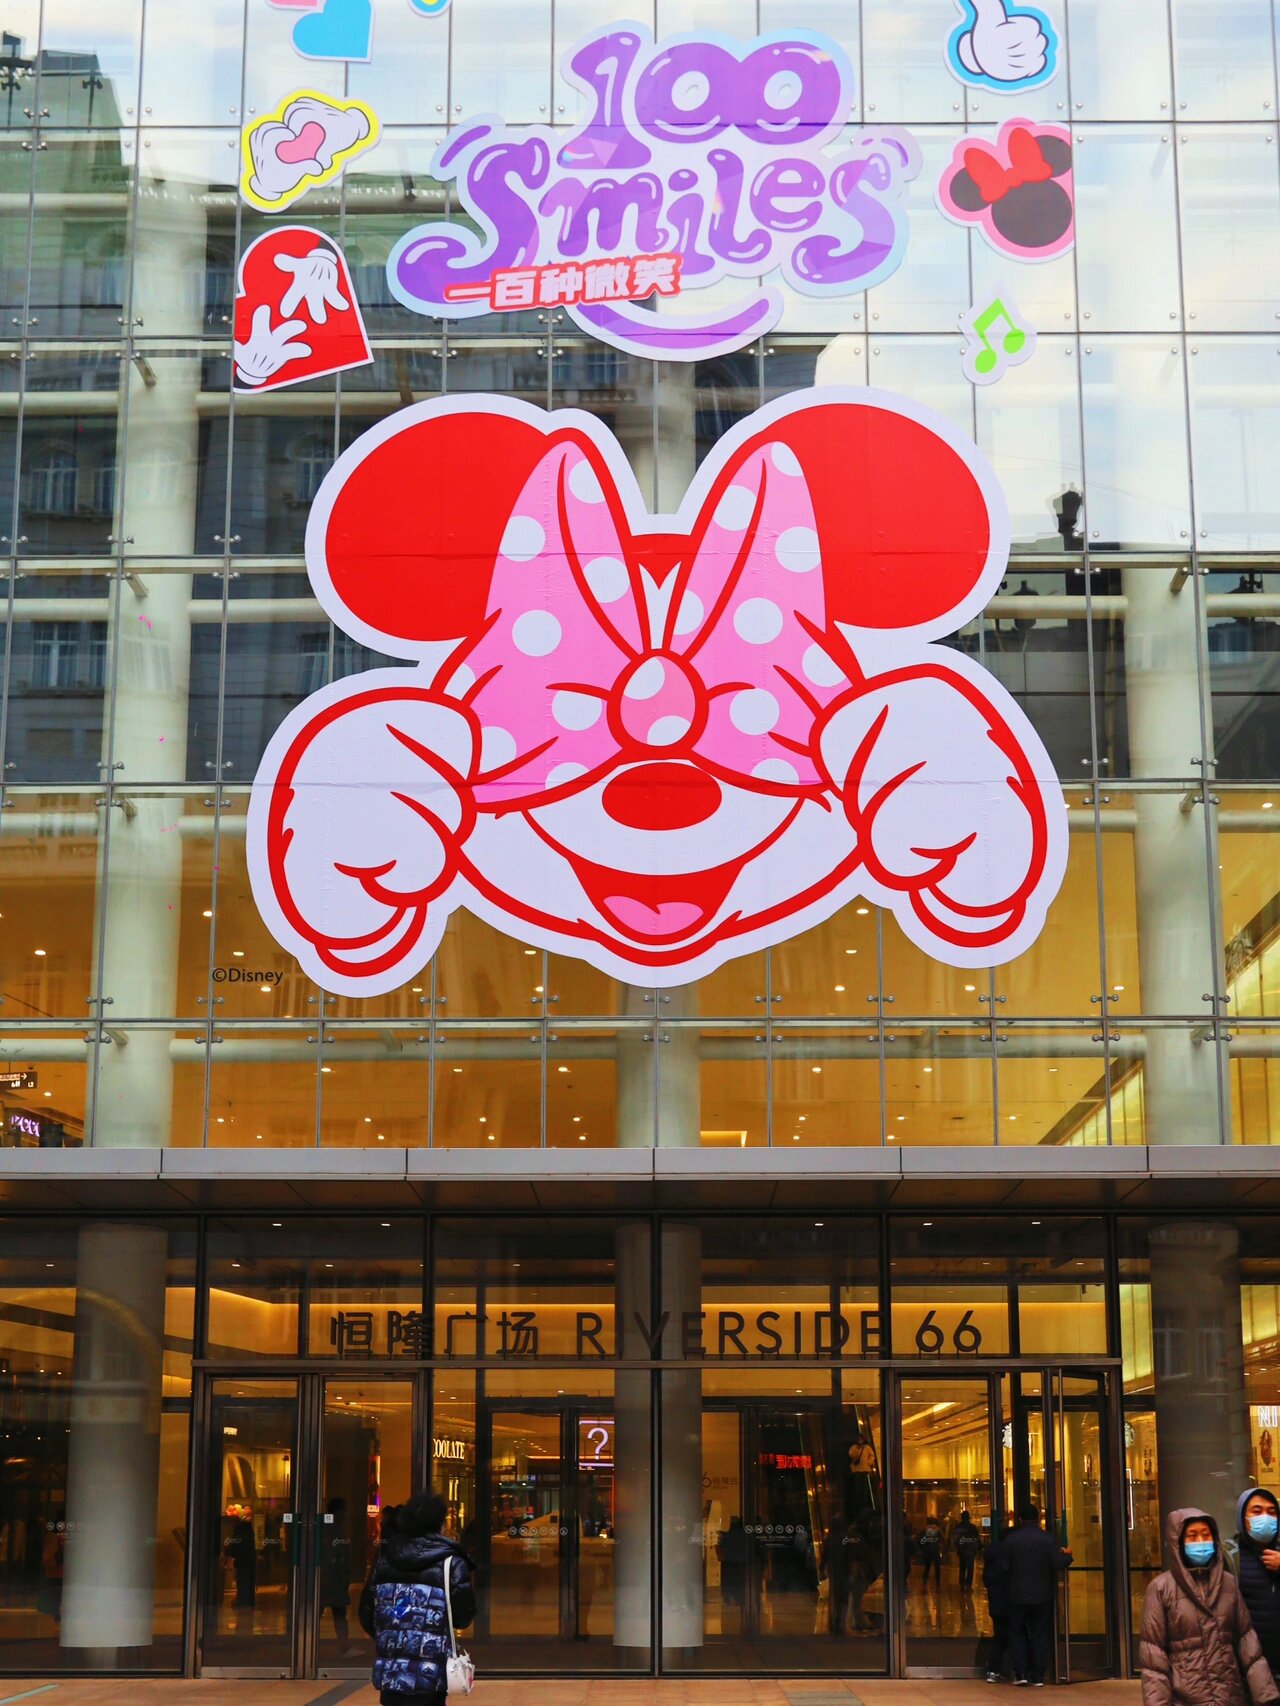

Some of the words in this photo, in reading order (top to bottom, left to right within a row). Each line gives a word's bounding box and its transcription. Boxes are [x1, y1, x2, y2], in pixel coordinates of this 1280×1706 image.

[570, 32, 842, 169] 100
[397, 137, 896, 303] Smiles
[449, 257, 677, 307] 一百种微笑
[330, 1310, 538, 1354] 恒隆广场
[576, 1310, 888, 1354] RIVERSIDE
[915, 1309, 982, 1353] 66
